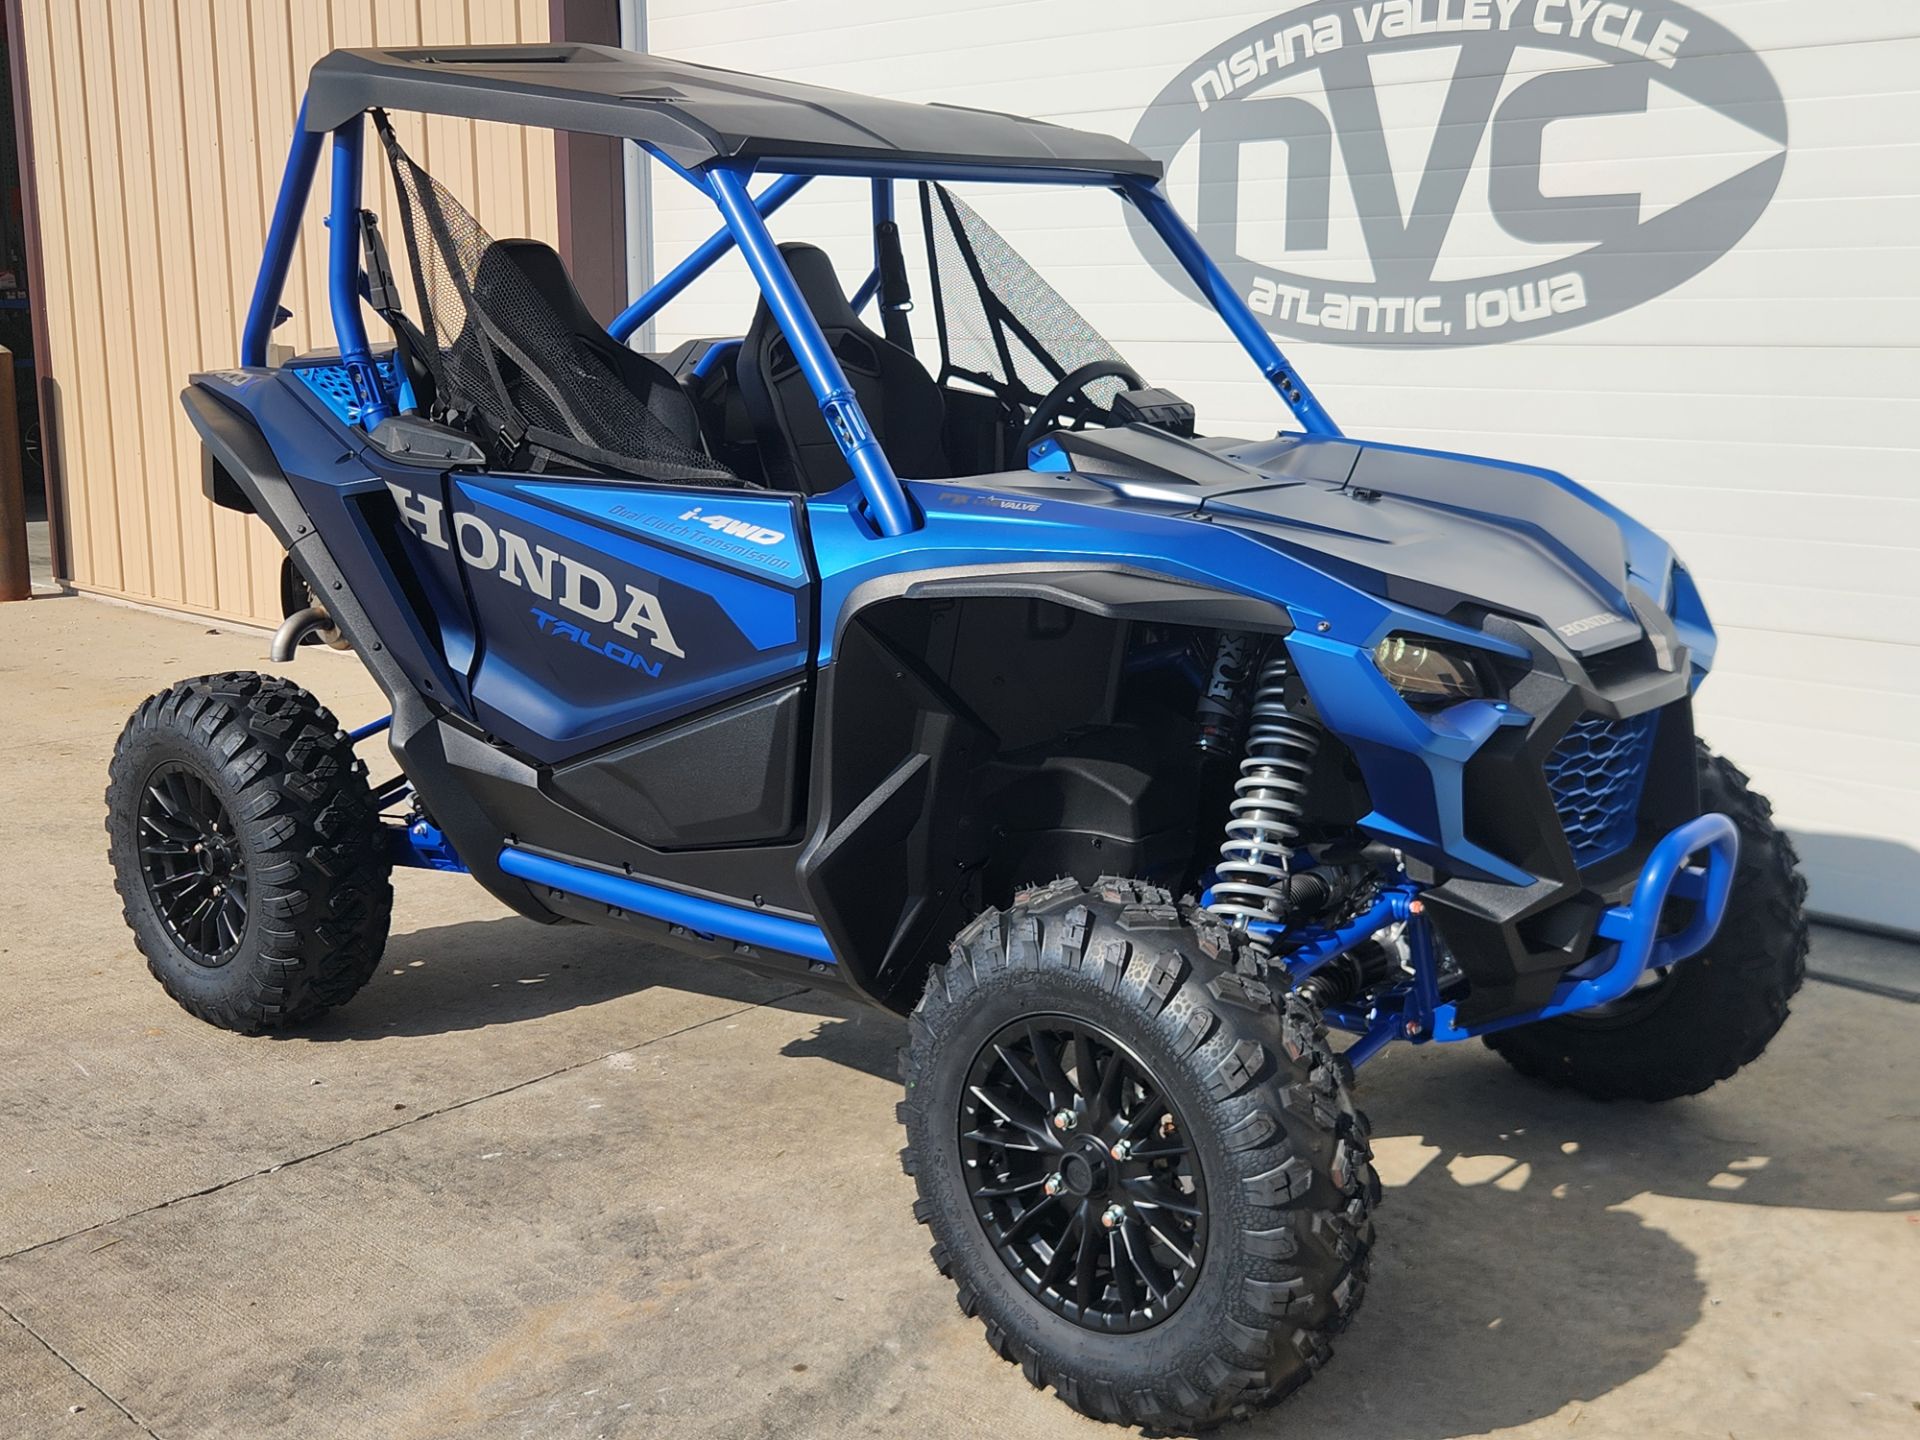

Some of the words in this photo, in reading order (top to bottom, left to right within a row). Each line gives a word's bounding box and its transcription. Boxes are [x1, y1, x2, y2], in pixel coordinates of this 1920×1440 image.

[1532, 0, 1689, 69] CYCLE
[608, 504, 641, 521] Dual
[641, 514, 689, 537] Clutch
[689, 529, 791, 570] Transmission
[678, 507, 786, 546] i-4WD
[1000, 500, 1041, 512] VALVE
[384, 480, 685, 659] HONDA
[530, 607, 663, 678] TALON
